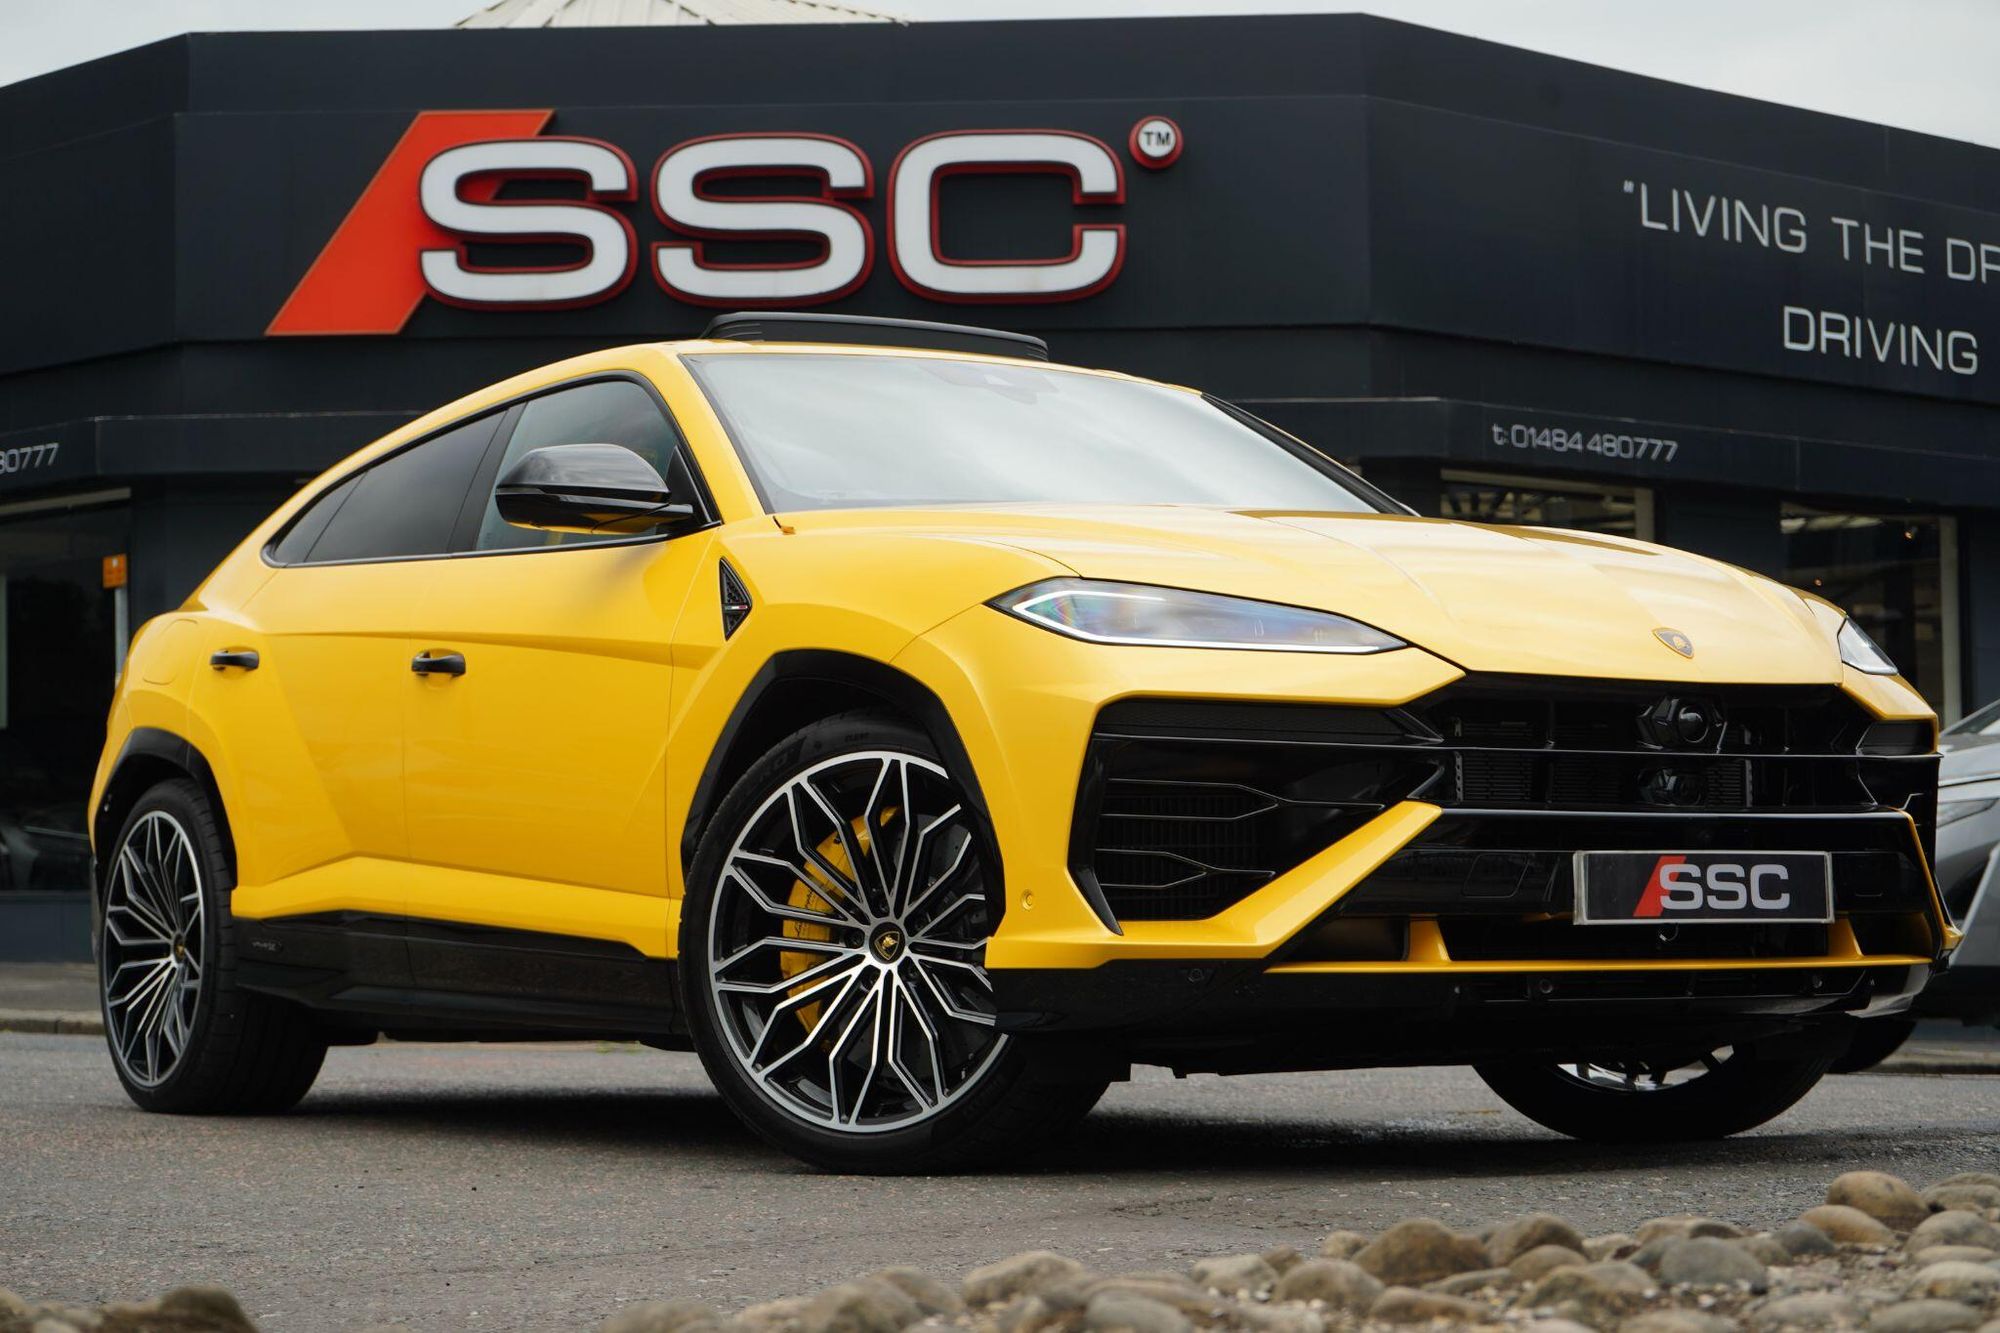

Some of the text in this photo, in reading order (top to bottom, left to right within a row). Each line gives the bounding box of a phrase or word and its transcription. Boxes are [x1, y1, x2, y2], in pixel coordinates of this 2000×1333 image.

[1143, 131, 1170, 146] TM
[419, 129, 1125, 309] SSC
[1623, 180, 1807, 253] "LIVING
[1830, 216, 1925, 274] THE
[1783, 305, 1978, 375] DRIVING
[1587, 433, 1679, 462] 480777
[1659, 864, 1790, 910] SSC
